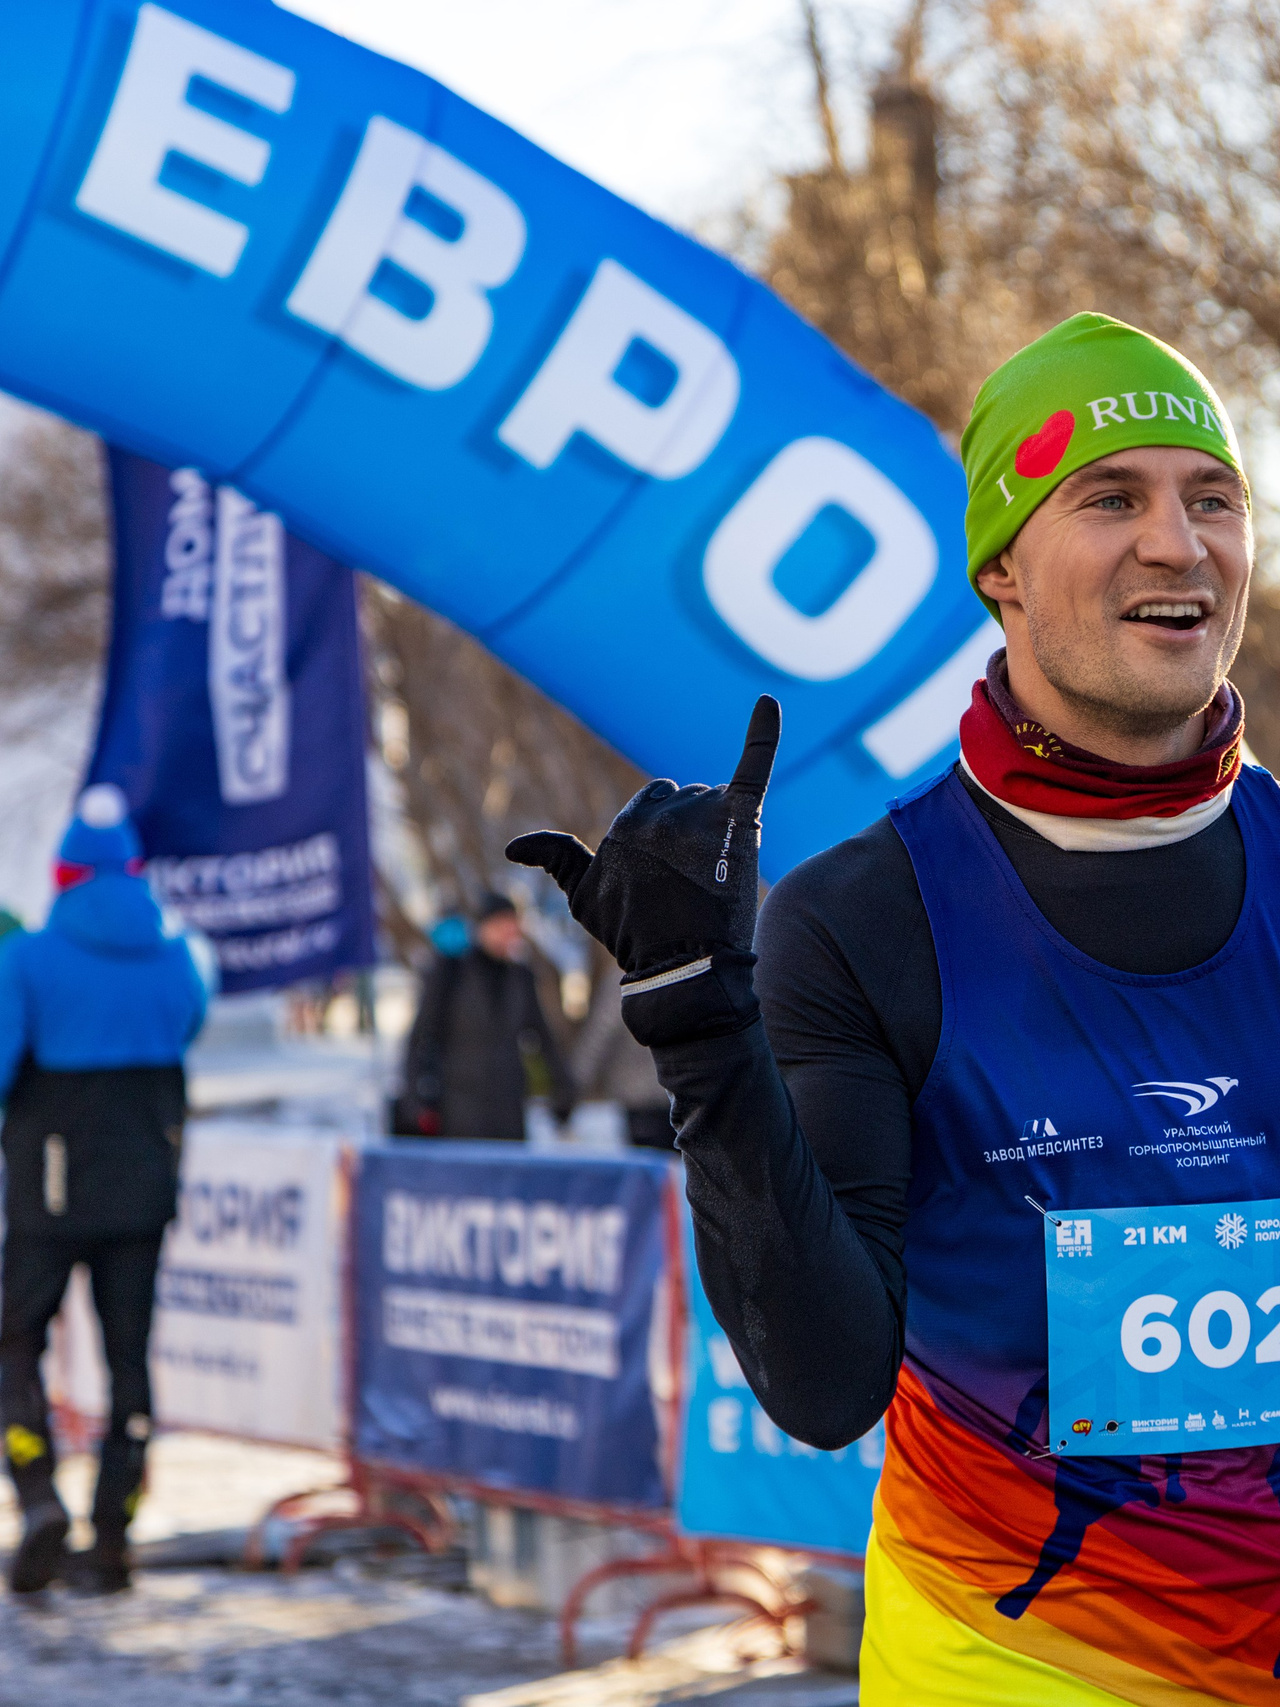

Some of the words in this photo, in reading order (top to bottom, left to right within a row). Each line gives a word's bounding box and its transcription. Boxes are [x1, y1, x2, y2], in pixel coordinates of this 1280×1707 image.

[996, 473, 1015, 507] I
[720, 817, 736, 857] Kalenji
[1163, 1121, 1232, 1139] УРАЛЬСКИЙ
[983, 1146, 1026, 1163] ЗАВОД
[1026, 1135, 1104, 1158] МЕДСИНТЕЗ
[1128, 1132, 1267, 1157] ГОРНОПРОМЫШЛЕННЫЙ
[1176, 1153, 1231, 1168] ХОЛДИНГ
[382, 1188, 627, 1298] ВИКТОРИЯ
[1123, 1227, 1146, 1246] 21
[1132, 1418, 1179, 1428] ВИКТОРИЯ
